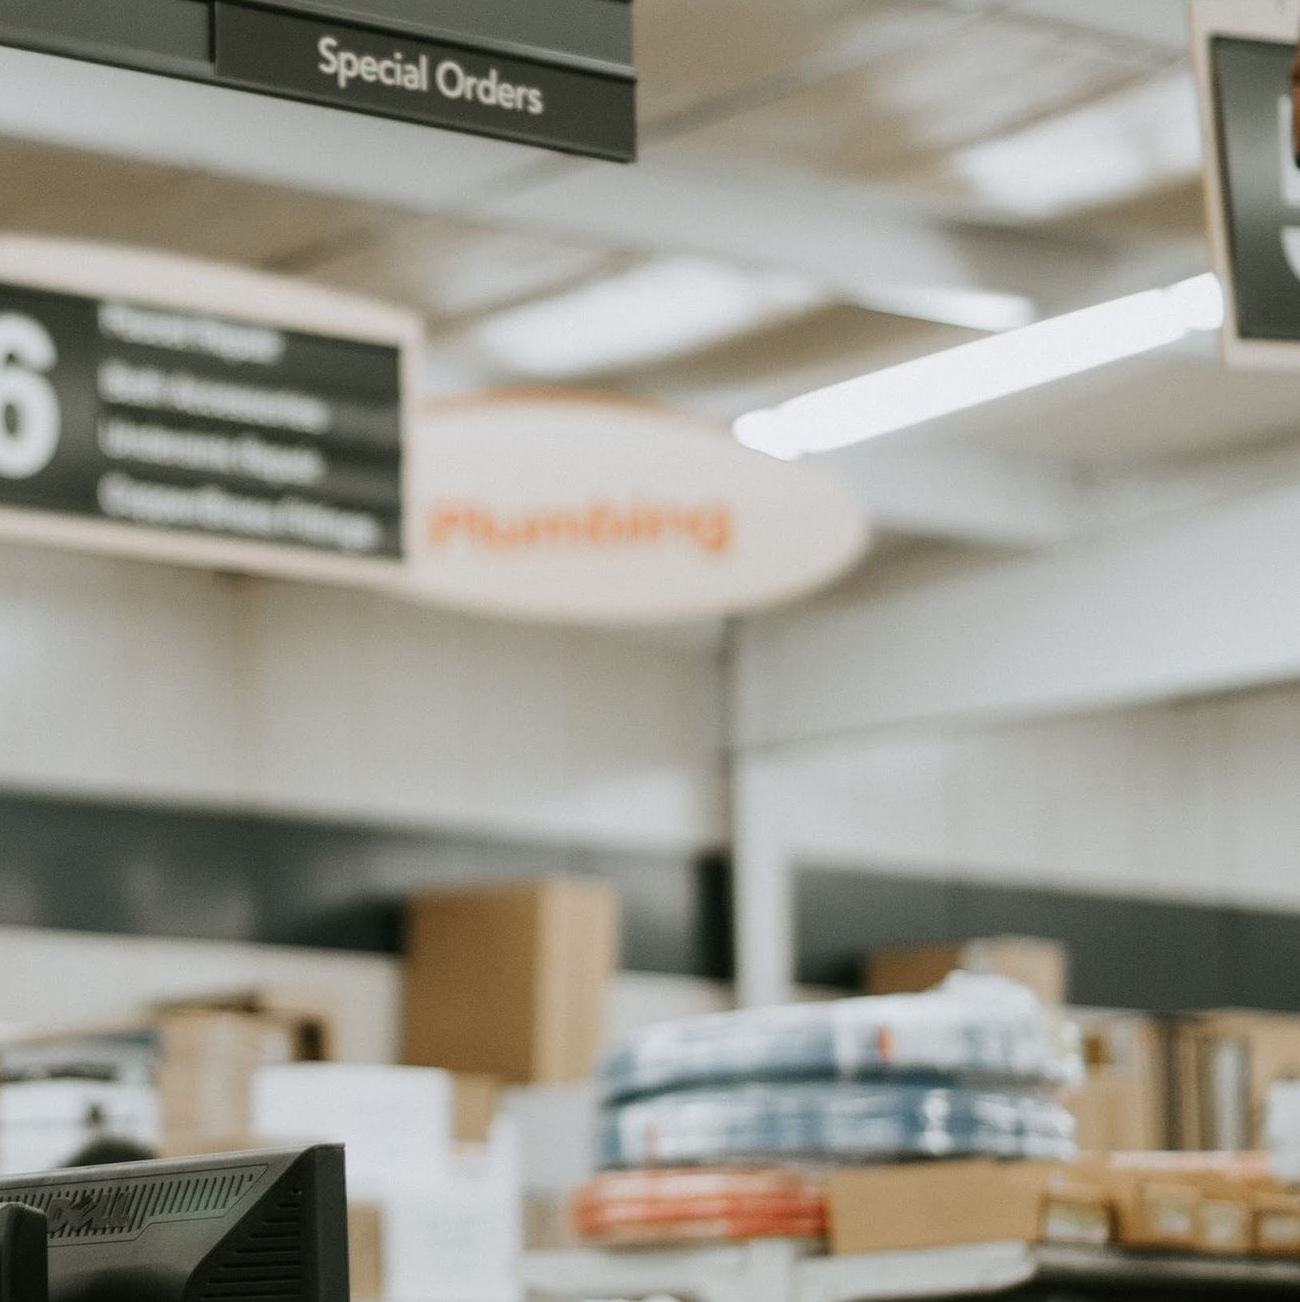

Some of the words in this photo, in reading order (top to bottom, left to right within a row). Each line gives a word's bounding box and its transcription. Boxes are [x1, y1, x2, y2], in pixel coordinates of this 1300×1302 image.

[318, 37, 428, 91] Special
[436, 61, 544, 115] Orders
[425, 497, 736, 557] Plumbing
